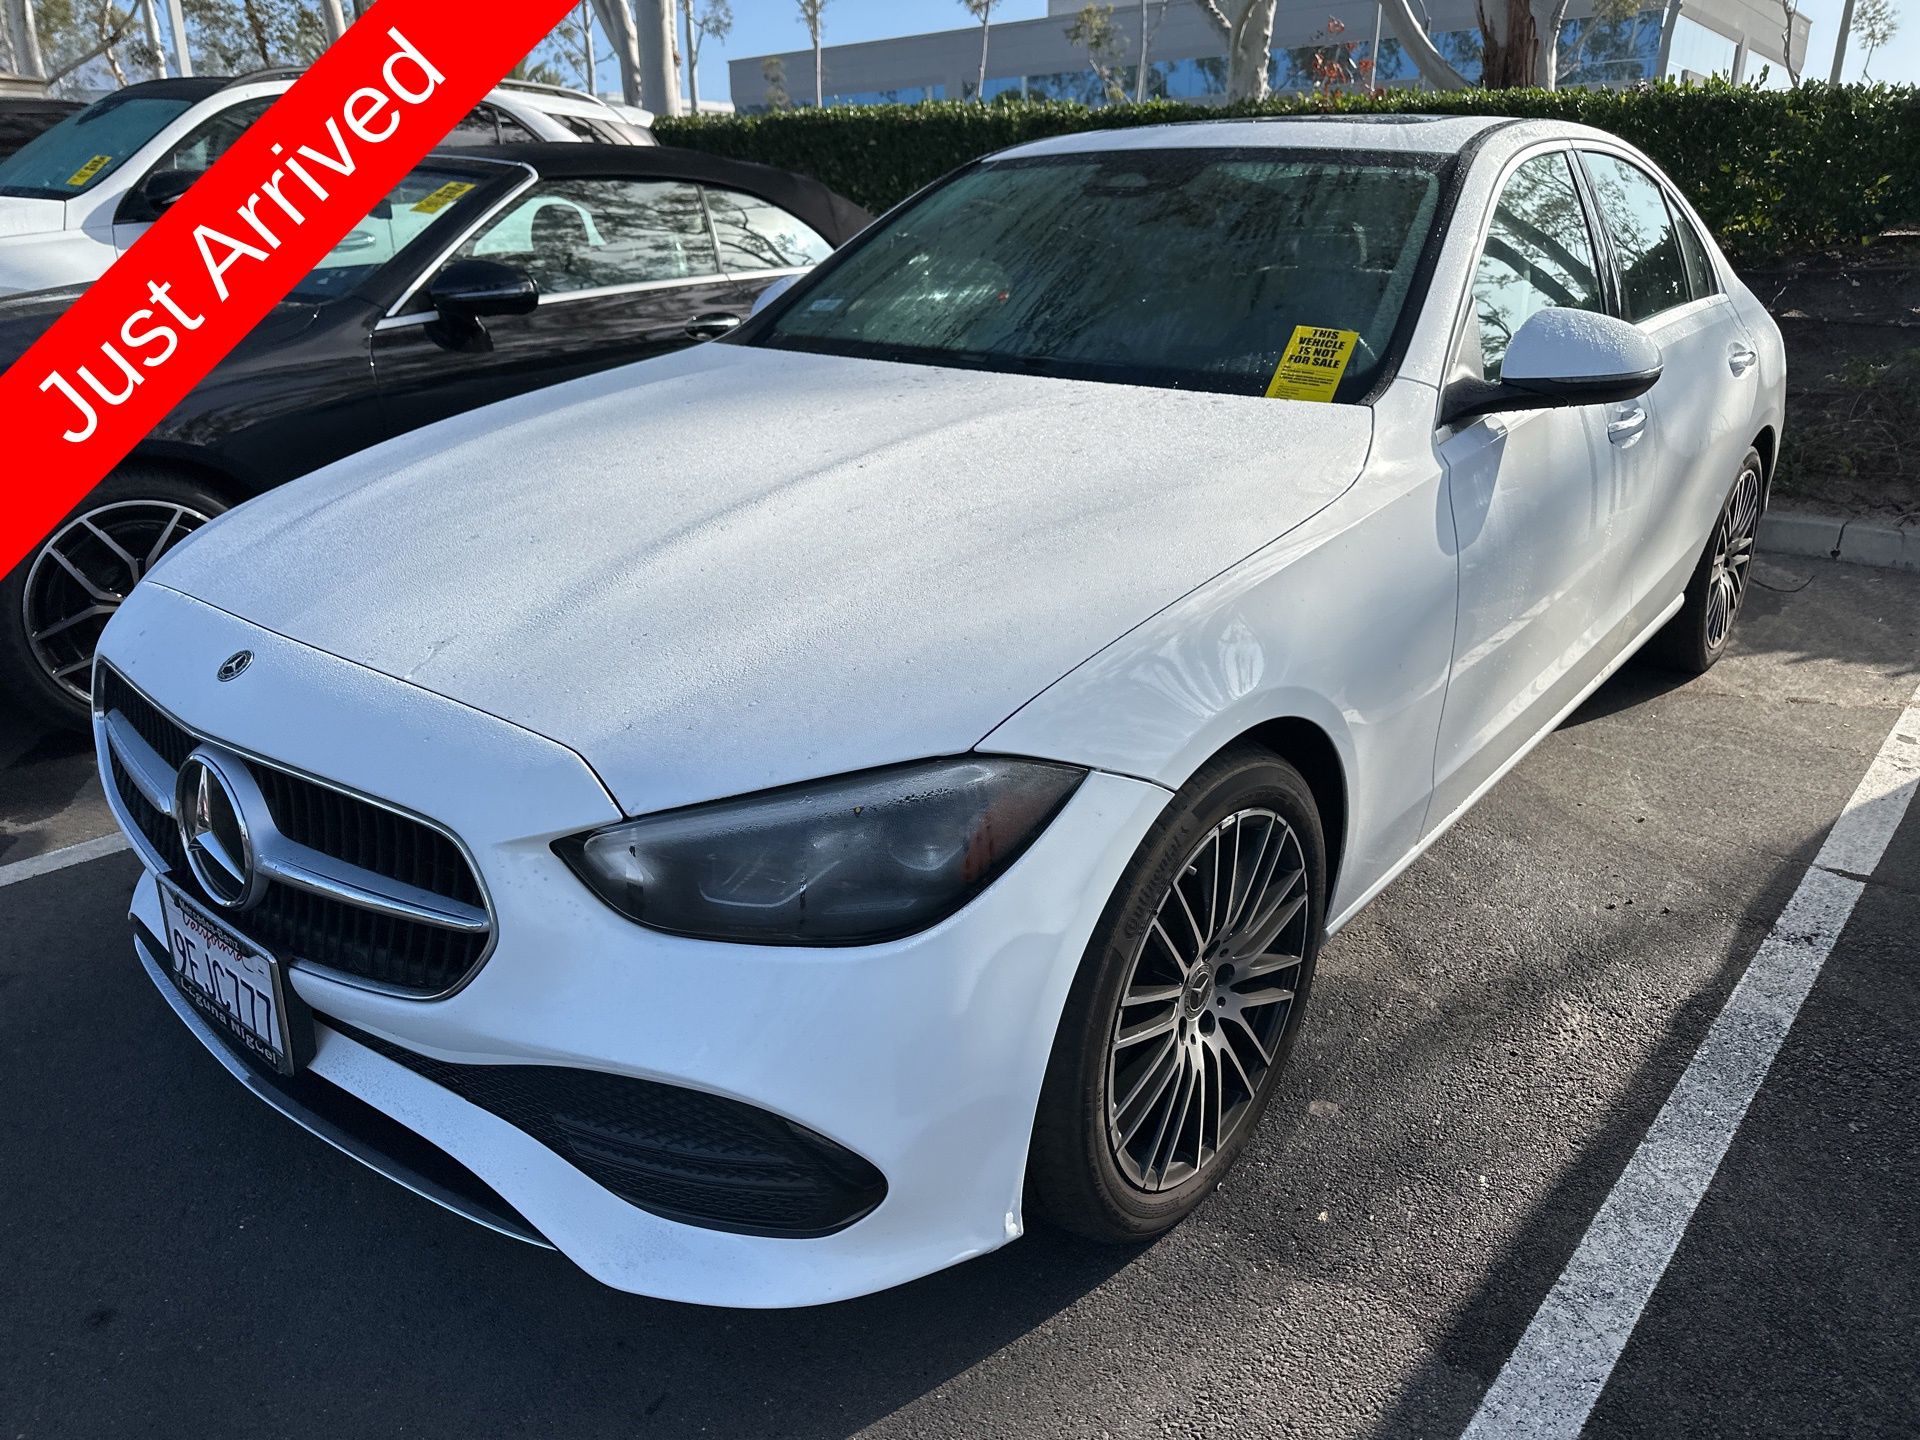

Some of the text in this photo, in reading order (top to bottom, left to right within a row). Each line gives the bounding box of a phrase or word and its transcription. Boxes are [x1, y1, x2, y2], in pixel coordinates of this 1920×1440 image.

[1311, 328, 1340, 340] THIS
[1298, 336, 1346, 350] VEHICLE
[1298, 346, 1338, 359] IS NOT
[1287, 354, 1341, 369] FOR SALE
[174, 929, 273, 1047] 9EJC777
[180, 977, 277, 1064] Laguna Niguel
